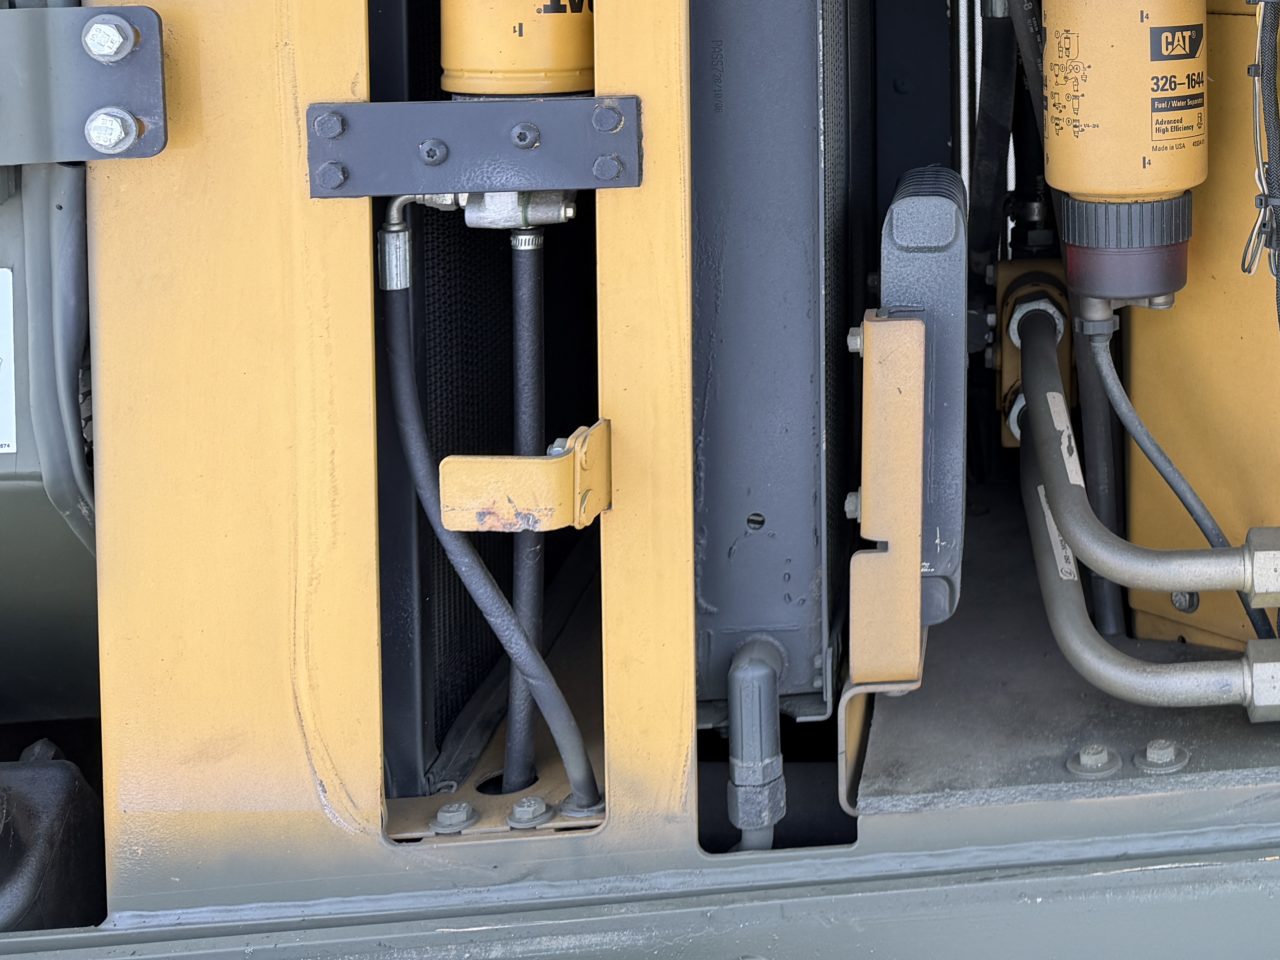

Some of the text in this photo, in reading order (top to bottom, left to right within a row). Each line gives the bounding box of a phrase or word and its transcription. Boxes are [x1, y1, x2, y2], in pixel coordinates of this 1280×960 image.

[1161, 31, 1192, 56] CAT
[1150, 71, 1204, 93] 326-1644
[1154, 100, 1167, 109] Fuel
[1171, 99, 1187, 108] Water
[1155, 116, 1183, 126] Advanced
[1155, 122, 1194, 135] High Efficiency
[1151, 144, 1168, 152] Made
[1175, 142, 1186, 150] USA
